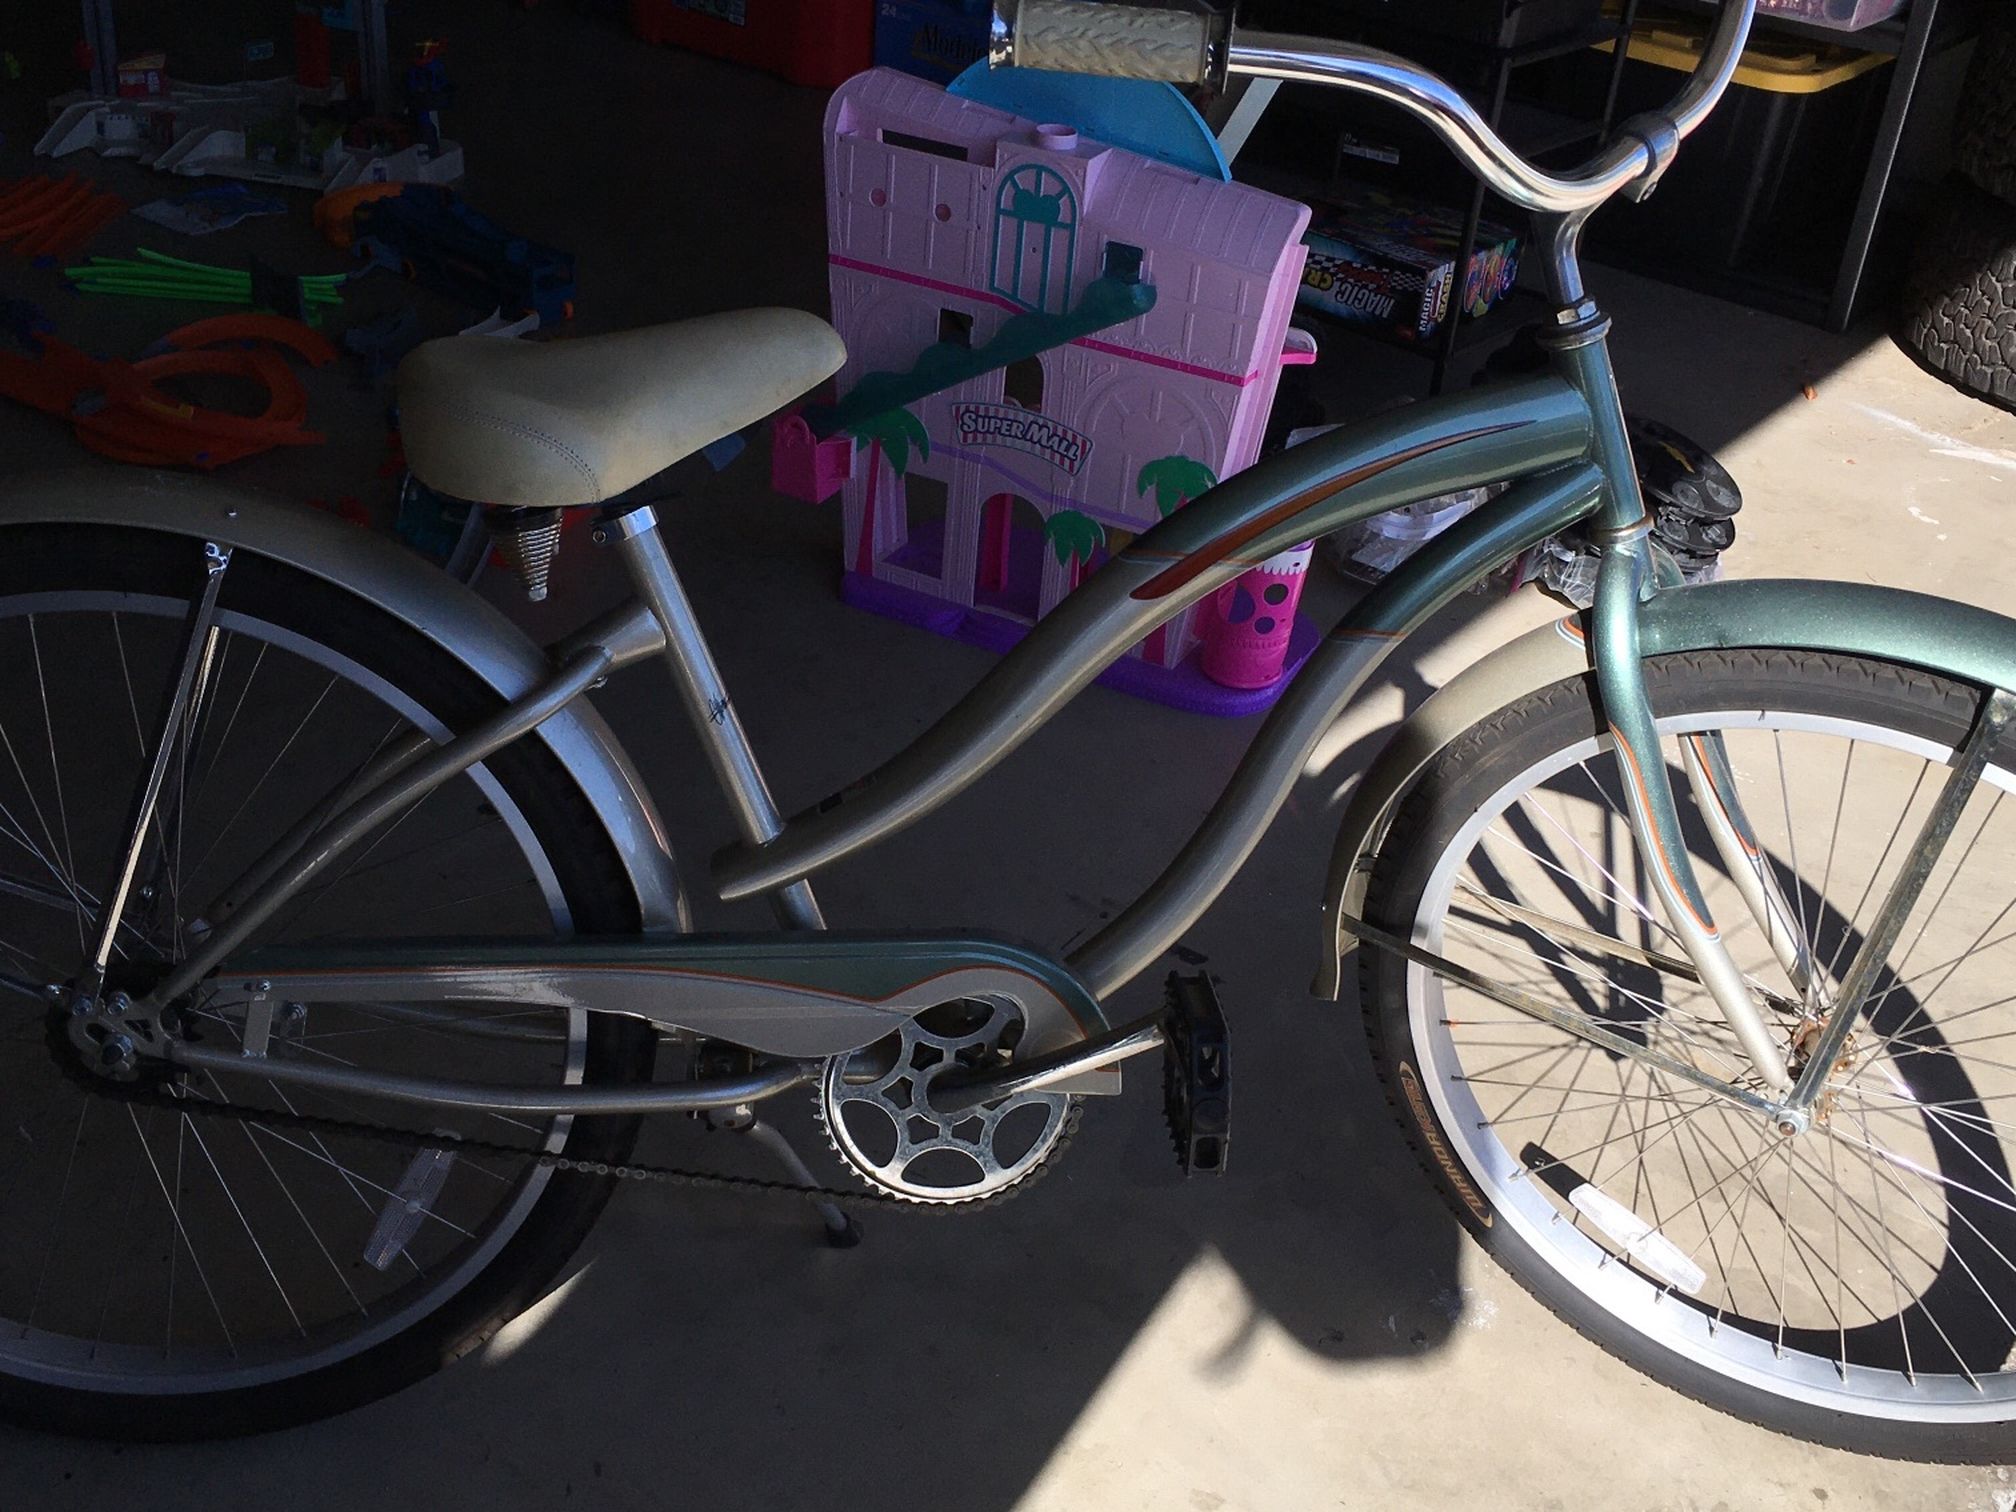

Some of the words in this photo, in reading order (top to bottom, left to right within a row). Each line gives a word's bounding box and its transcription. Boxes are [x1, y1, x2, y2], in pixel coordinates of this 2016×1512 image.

[1335, 280, 1396, 318] MAGIC
[1418, 288, 1433, 332] MAGIC
[960, 411, 1025, 439] SUPER
[1025, 421, 1079, 461] MALL
[1423, 1131, 1486, 1210] WANDA
